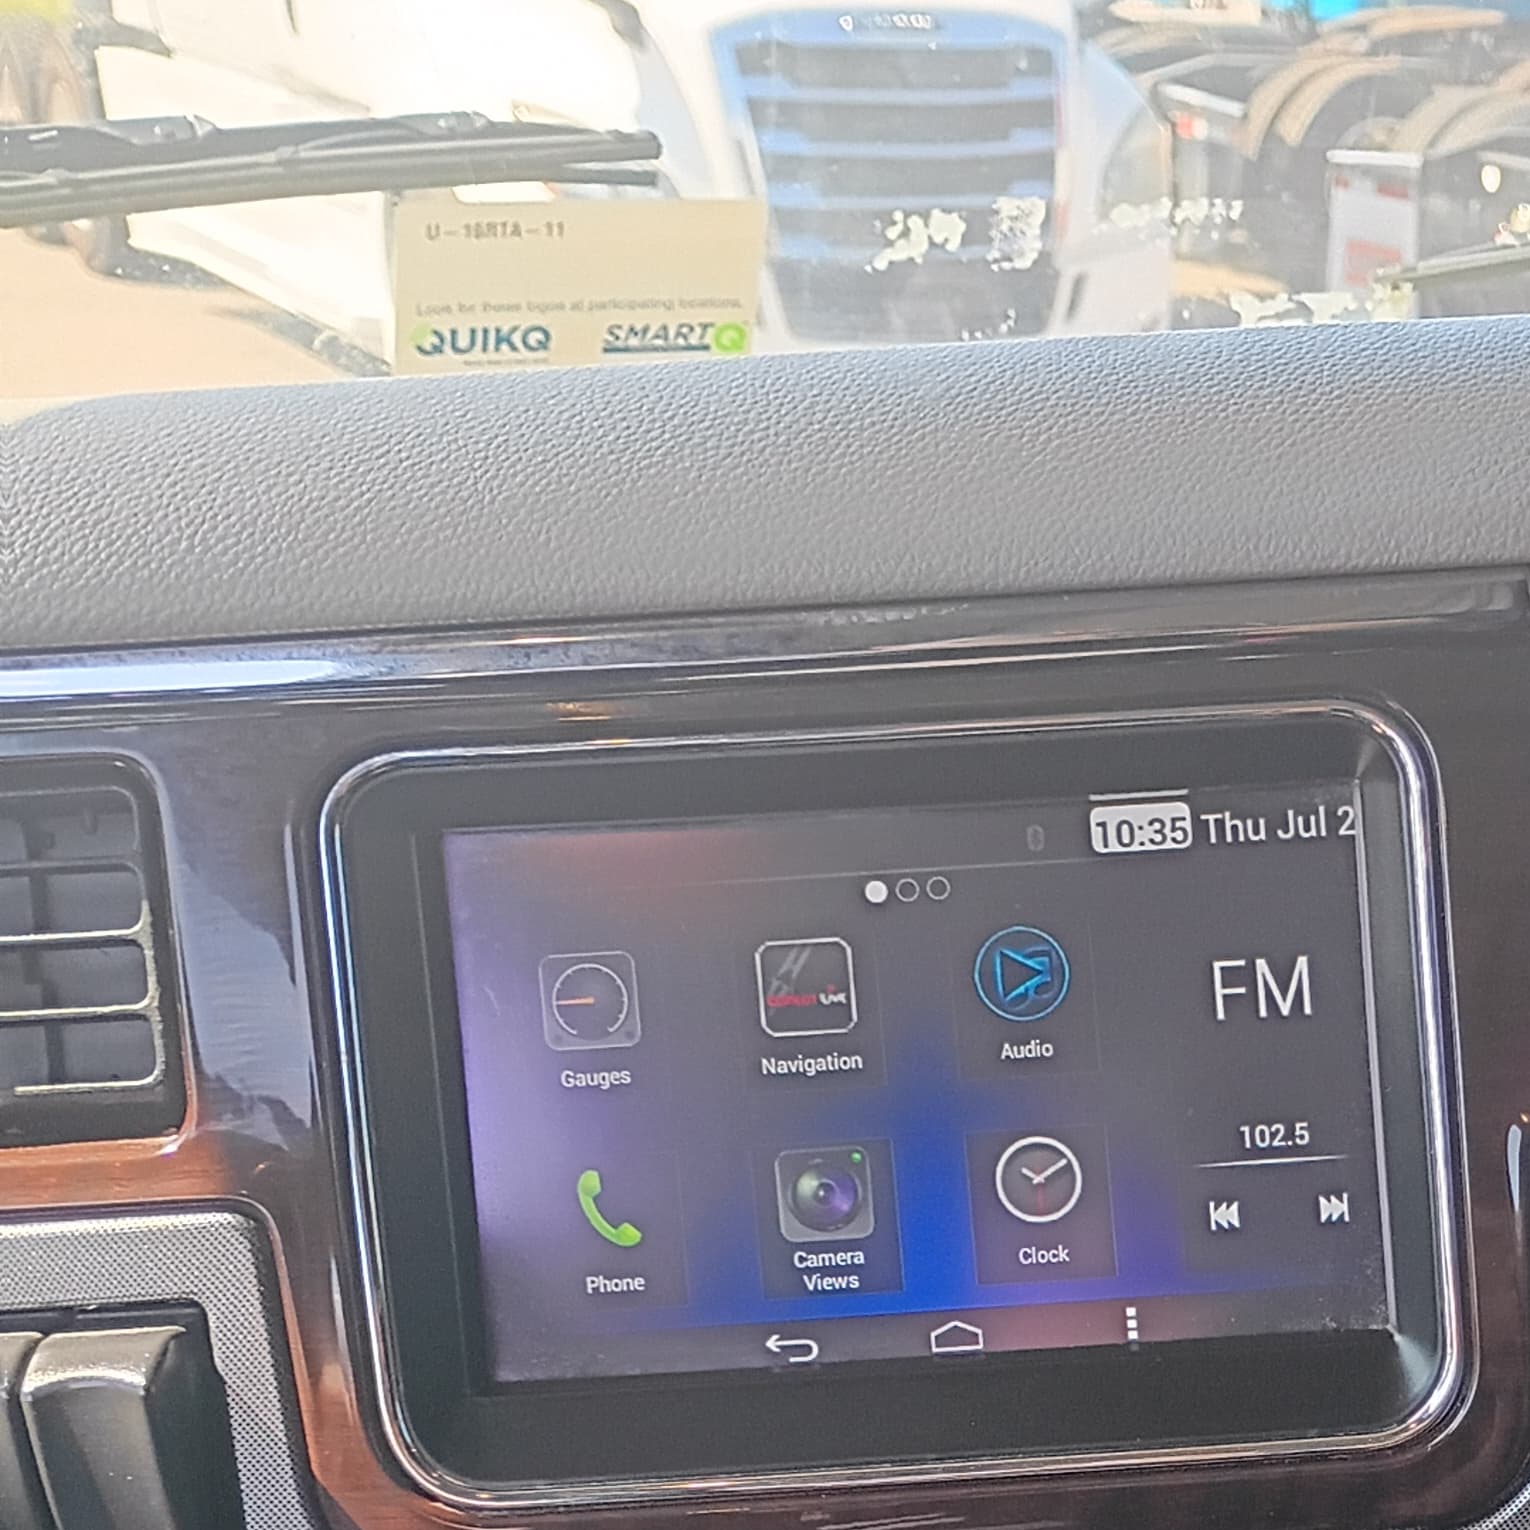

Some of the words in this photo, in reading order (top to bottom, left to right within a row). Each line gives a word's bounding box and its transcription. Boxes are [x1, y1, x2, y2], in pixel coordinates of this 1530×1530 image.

[411, 323, 553, 356] QUIKQ
[1095, 815, 1190, 850] 10:35
[1201, 812, 1267, 845] Thu
[1277, 805, 1327, 840] Jul
[1212, 956, 1313, 1021] FM
[1000, 1040, 1054, 1061] Audio
[761, 1051, 864, 1078] Navigation
[560, 1067, 632, 1090] Gauges
[1239, 1121, 1312, 1149] 102.5
[793, 1246, 865, 1268] Camera
[1018, 1244, 1071, 1266] Clock
[585, 1274, 646, 1295] Phone
[803, 1271, 860, 1293] Views
